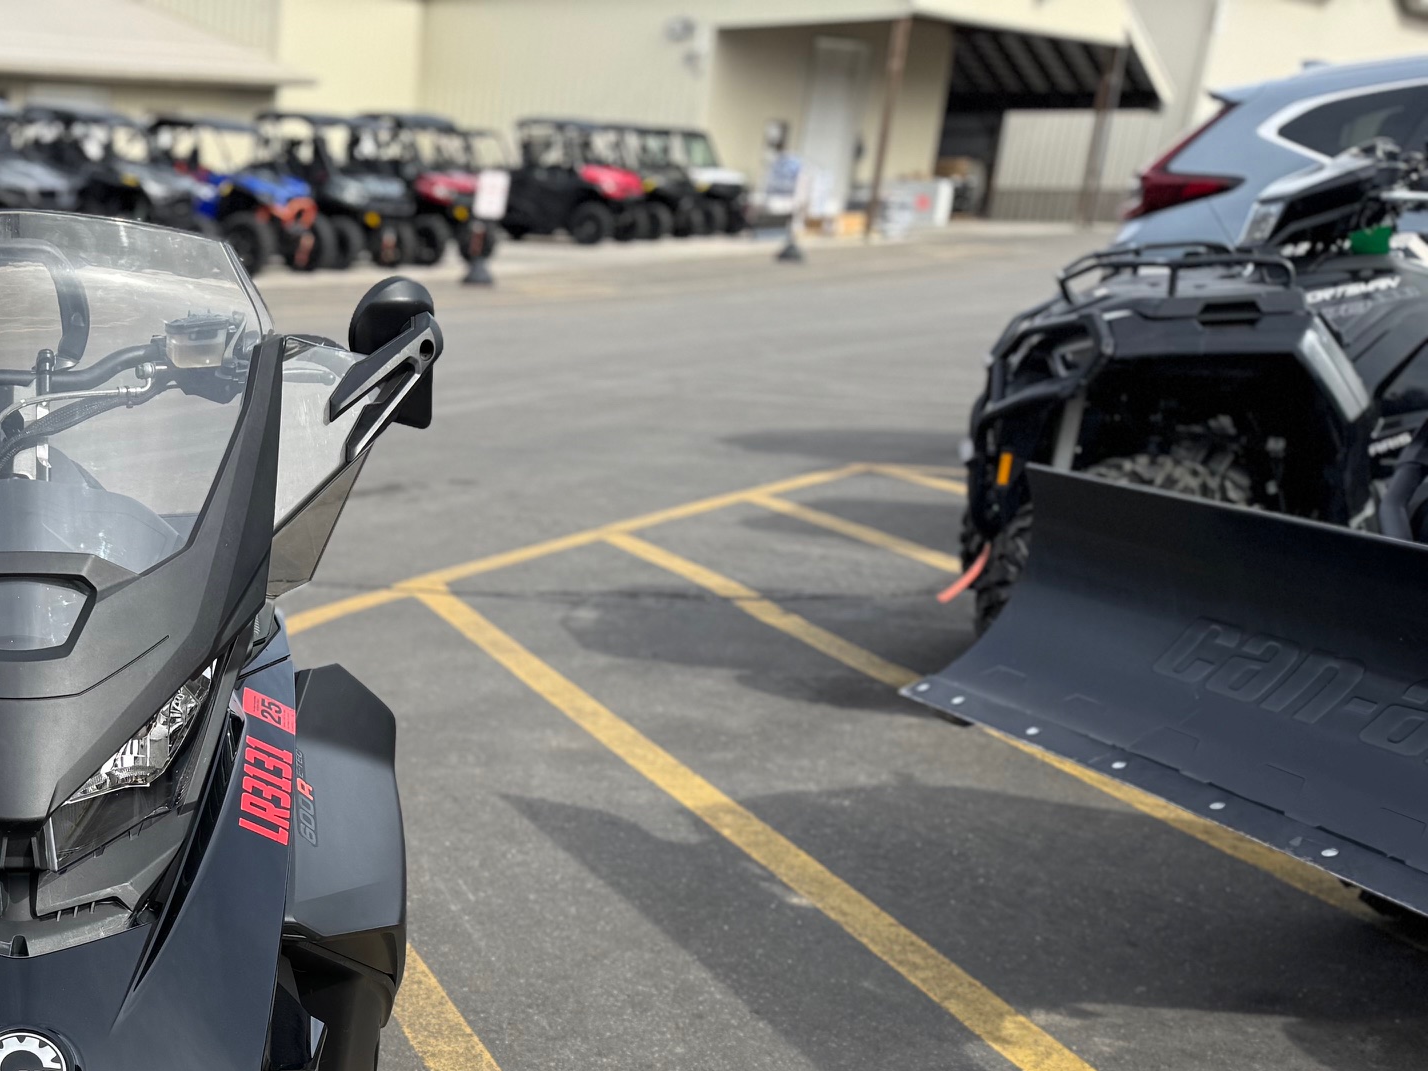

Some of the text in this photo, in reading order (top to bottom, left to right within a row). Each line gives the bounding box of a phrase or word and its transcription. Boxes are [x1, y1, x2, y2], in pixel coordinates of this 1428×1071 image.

[260, 697, 283, 726] 25
[1152, 616, 1428, 757] can-a
[238, 735, 293, 846] LR3131
